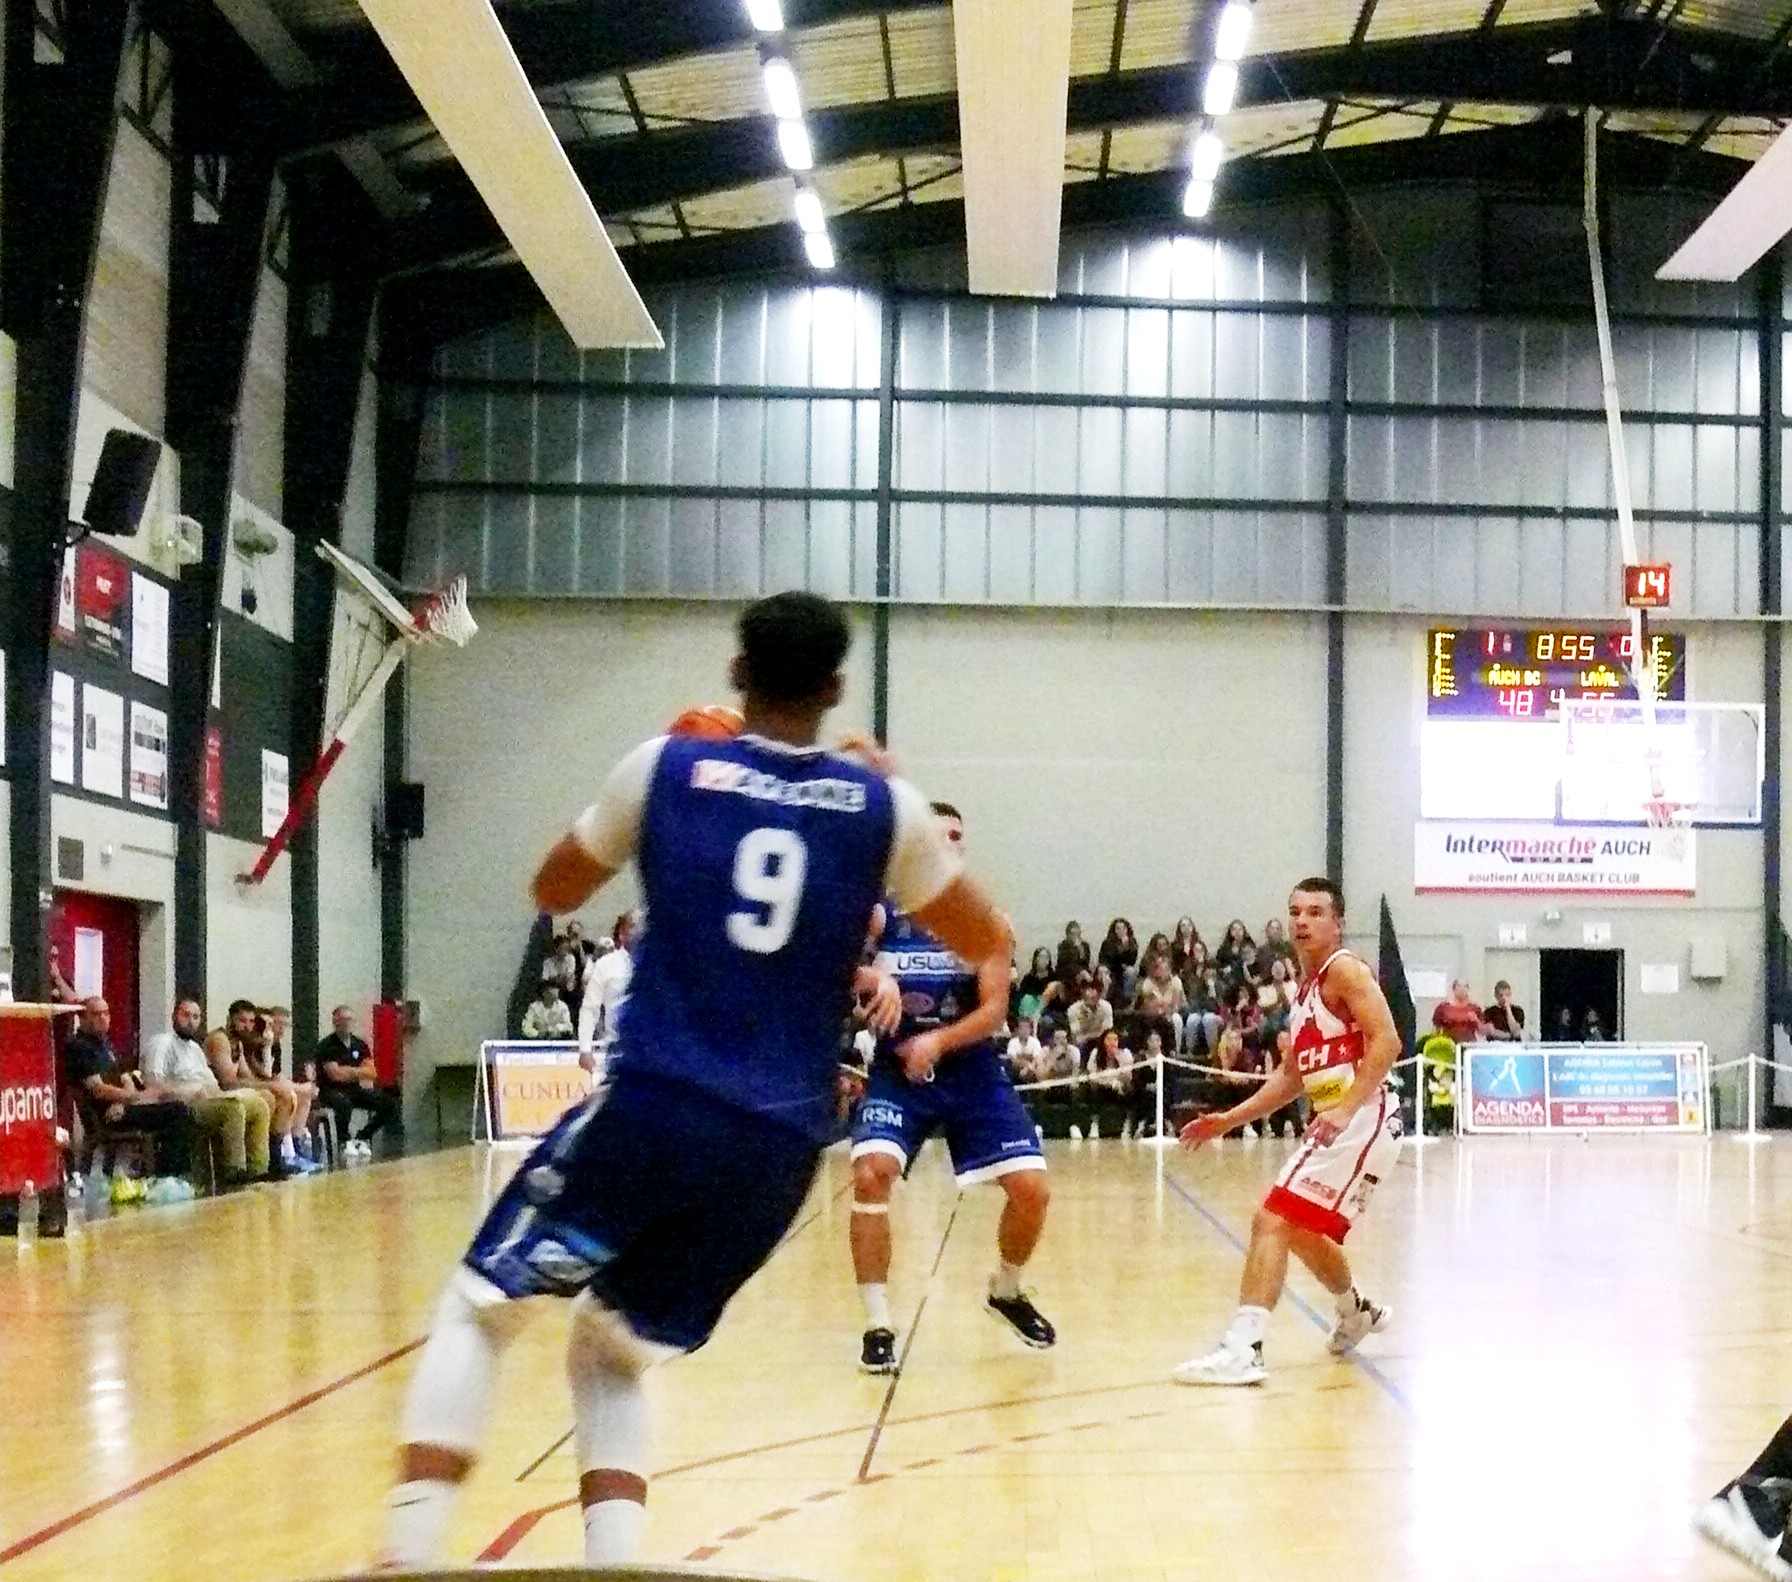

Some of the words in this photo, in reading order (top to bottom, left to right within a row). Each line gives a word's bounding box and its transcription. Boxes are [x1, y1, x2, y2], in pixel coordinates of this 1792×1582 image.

[1638, 571, 1665, 596] 14
[1580, 669, 1620, 687] LAVAL
[1499, 689, 1534, 716] 48
[1446, 834, 1597, 861] Intermarché
[1600, 840, 1651, 856] AUCH
[1521, 872, 1556, 884] AUCH
[1557, 873, 1605, 885] BASKET
[1608, 873, 1641, 884] CLUB
[727, 827, 809, 955] 9
[862, 1107, 903, 1128] RSM
[1474, 1100, 1545, 1117] AGENDA
